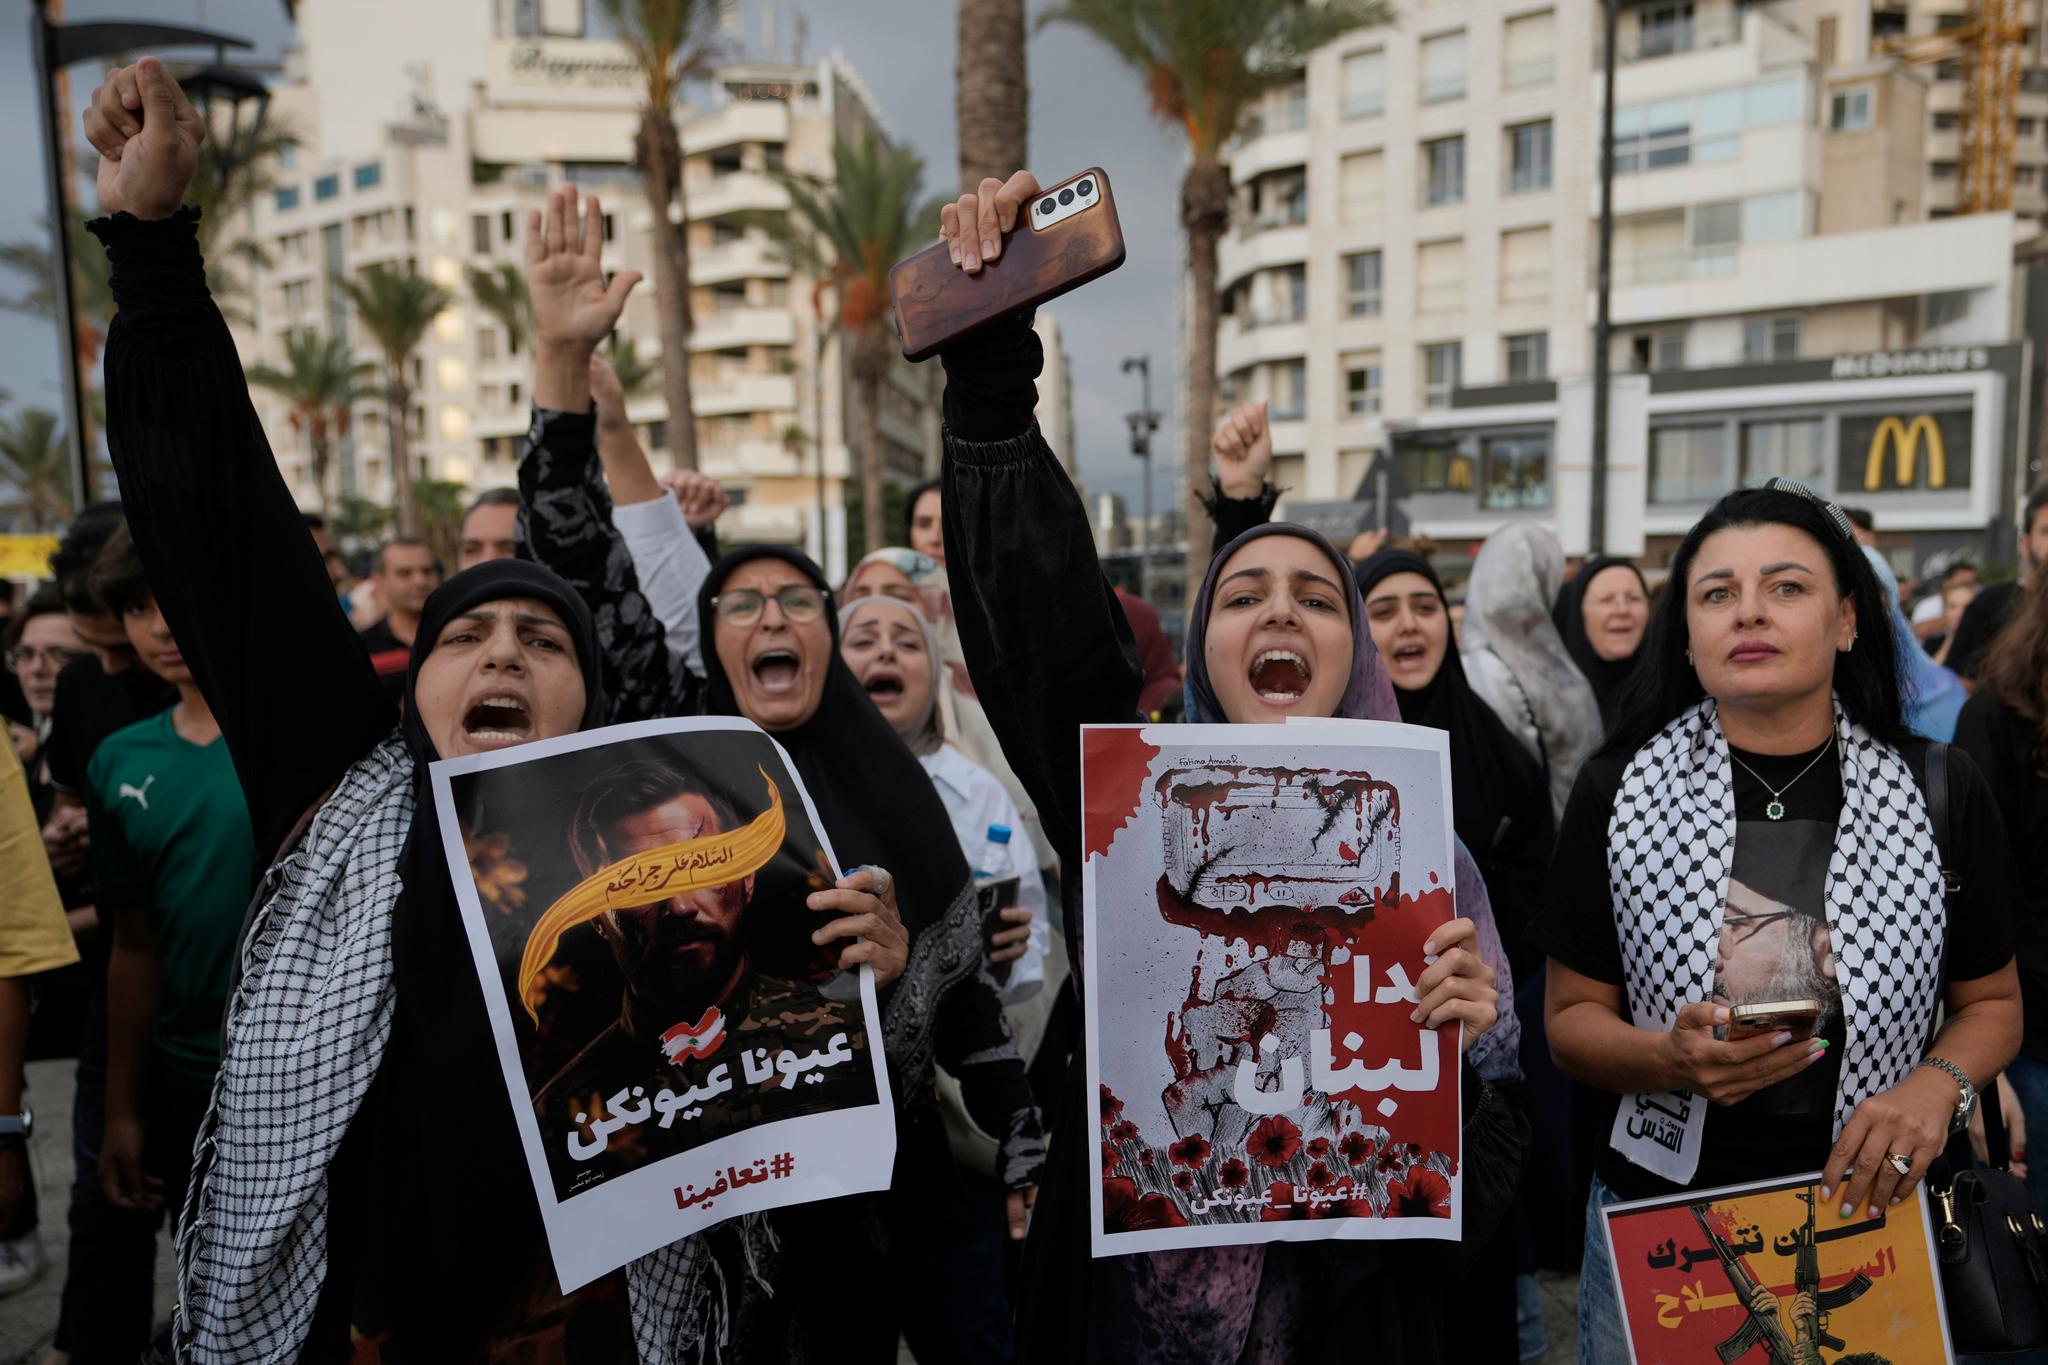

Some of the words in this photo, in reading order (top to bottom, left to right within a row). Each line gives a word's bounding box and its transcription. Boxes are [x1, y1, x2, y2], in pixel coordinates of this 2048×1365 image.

[1353, 954, 1440, 1005] دا
[741, 1032, 852, 1090] عيونا
[1234, 1029, 1440, 1118] لبنان
[567, 1063, 733, 1162] عيونكن
[1626, 1116, 1685, 1155] القدس
[673, 1152, 794, 1211] #تعافينا
[1647, 1225, 1765, 1273] نترك
